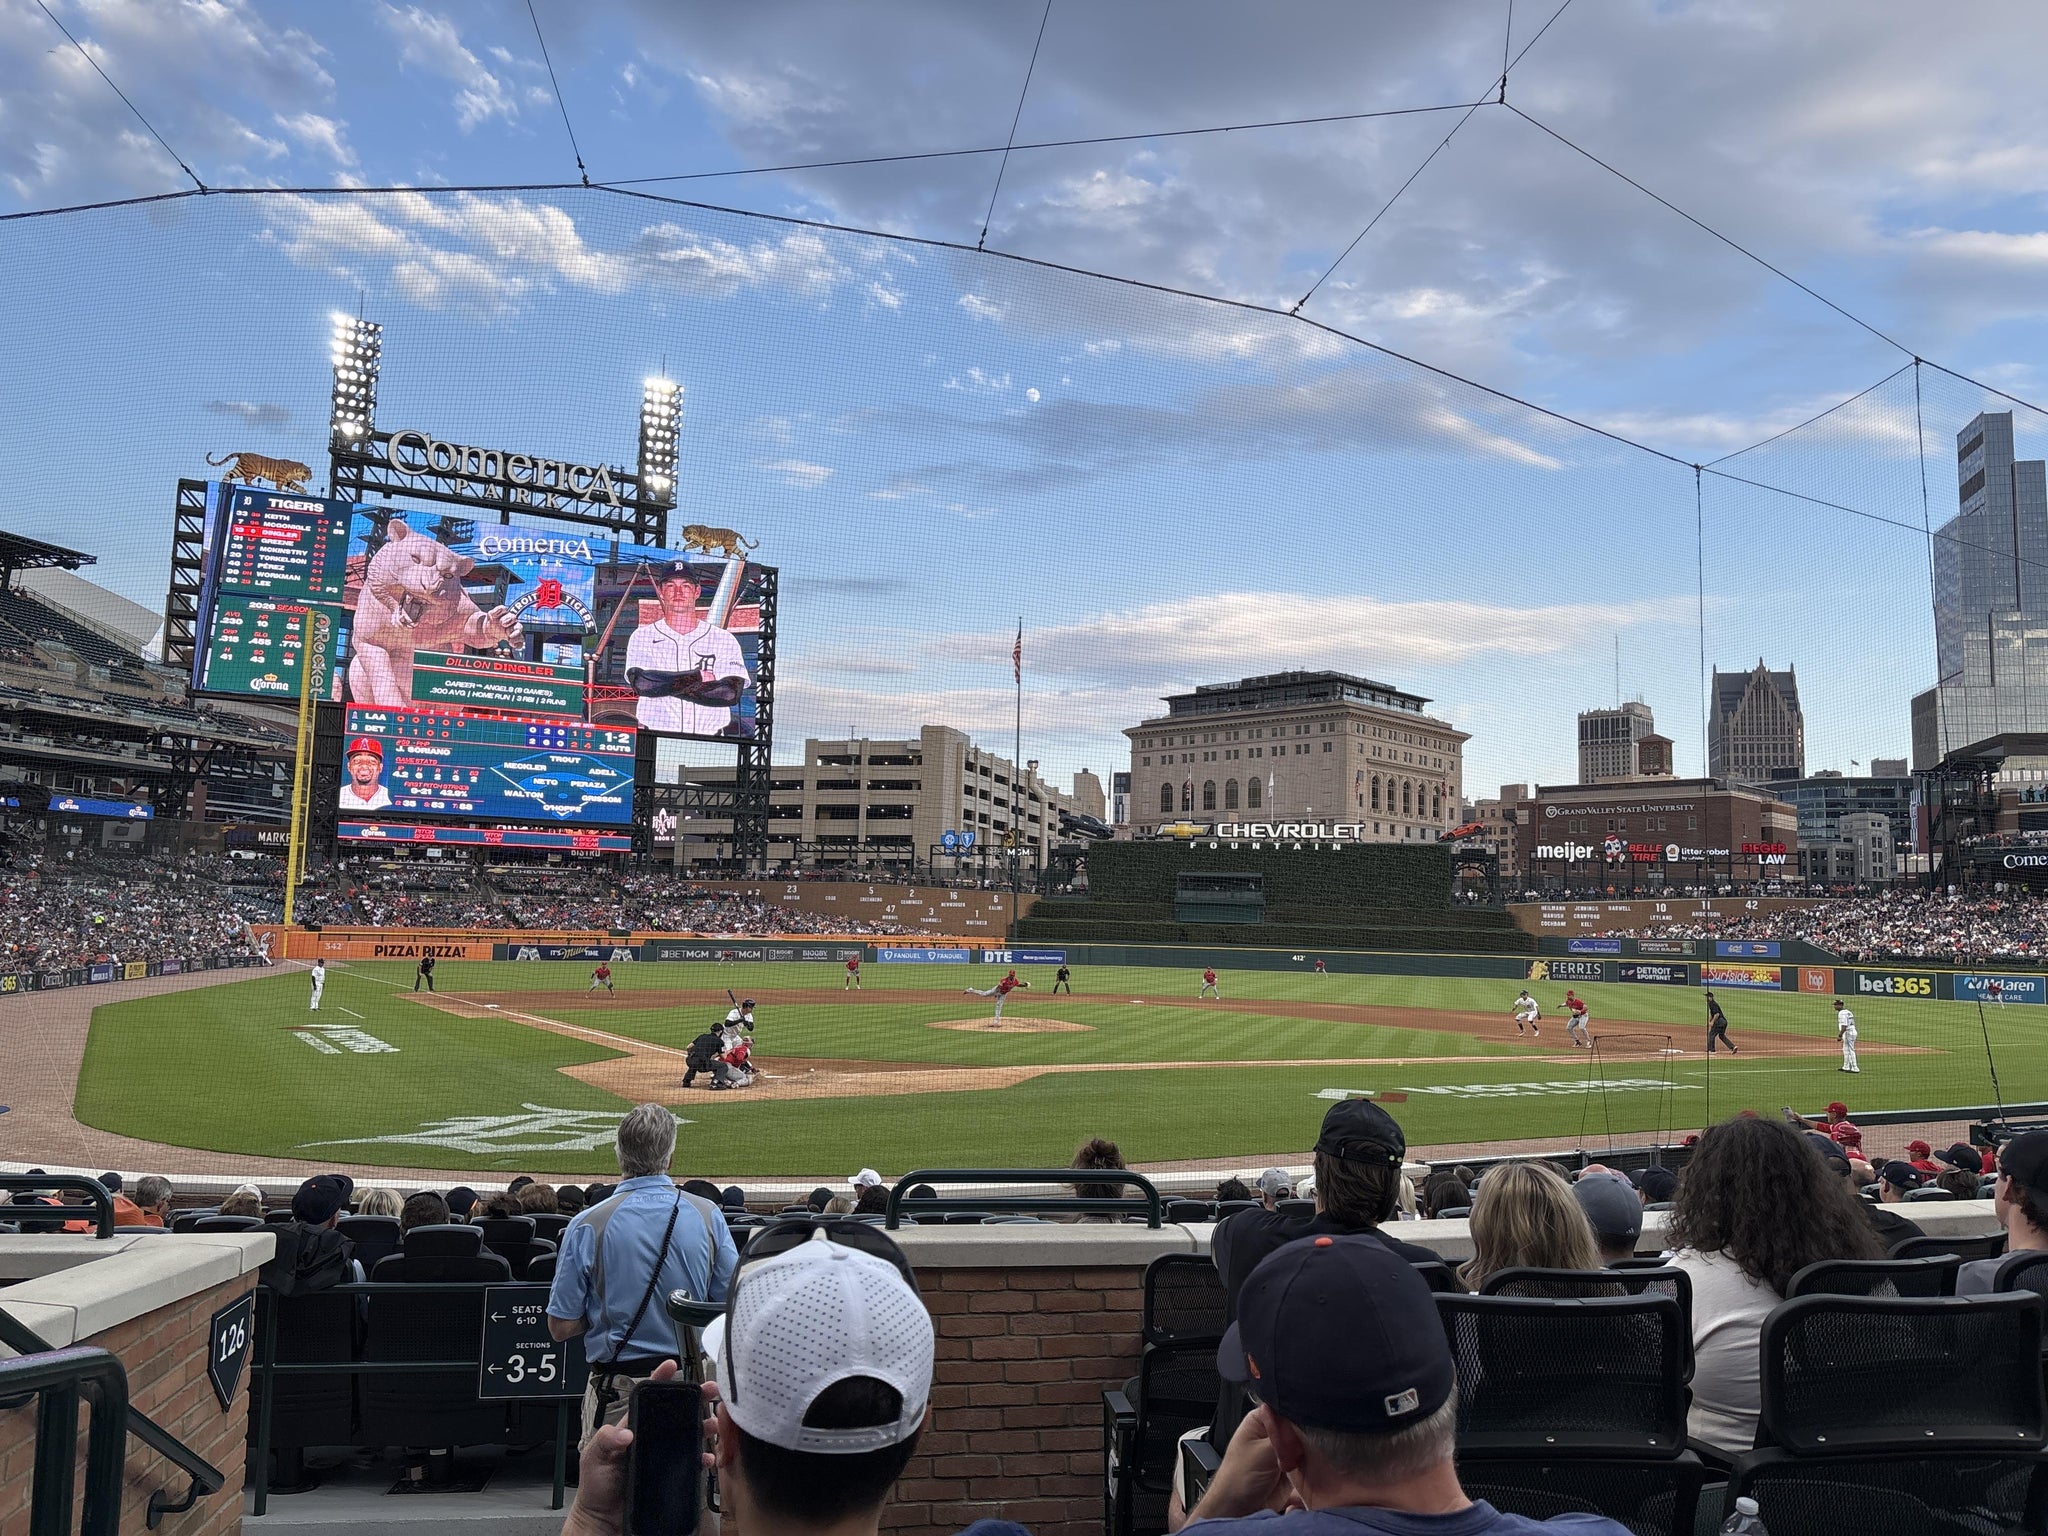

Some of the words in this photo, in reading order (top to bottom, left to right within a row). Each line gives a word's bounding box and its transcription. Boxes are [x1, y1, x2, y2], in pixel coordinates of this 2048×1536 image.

[455, 479, 562, 509] PARK
[268, 498, 324, 512] TIGERS
[263, 522, 311, 531] MCGONIGLE
[262, 530, 297, 538] DINGLER
[260, 546, 308, 556] MCKINSTRY
[259, 554, 307, 564] TORKELSON
[513, 558, 563, 567] PARK
[256, 572, 300, 581] WORKMAN
[276, 604, 312, 613] SEASON
[566, 595, 595, 628] TIGERS
[446, 658, 491, 669] DILLON
[493, 660, 554, 676] DINGLER
[250, 678, 288, 691] Corona
[445, 680, 475, 688] CAREER
[484, 684, 513, 692] ANGELS
[605, 732, 630, 743] 1-2
[408, 747, 451, 755] SORIANO
[504, 762, 546, 771] MECKLER
[570, 780, 606, 789] PERAZA
[504, 790, 544, 798] WALTON
[582, 795, 622, 803] GRISSOM
[59, 802, 79, 810] Corona
[1558, 806, 1586, 815] GRAND
[1586, 806, 1615, 814] VALLEY
[1616, 806, 1641, 814] STATE
[1642, 804, 1694, 813] UNIVERSITY
[361, 828, 386, 837] Corona
[1217, 824, 1365, 838] CHEVROLET
[1190, 842, 1341, 850] FOUNTAIN
[1741, 843, 1786, 853] FIEGER
[1537, 841, 1594, 862] meijer
[1682, 848, 1729, 856] litter-robot
[1759, 854, 1786, 864] LAW
[2004, 854, 2048, 868] Come
[950, 892, 958, 900] 16
[993, 895, 998, 903] 6
[1656, 903, 1666, 912] 10
[1702, 901, 1710, 909] 11
[1745, 901, 1758, 910] 42
[374, 945, 419, 957] PIZZA!
[422, 946, 466, 958] PIZZA!
[561, 946, 588, 960] Miller
[985, 951, 1012, 962] DTE
[1552, 962, 1601, 974] FERRIS
[1708, 966, 1749, 982] Surfside
[1808, 972, 1823, 990] hop
[1859, 974, 1931, 994] bet365
[1393, 1079, 1678, 1094] VICTORS
[512, 1306, 542, 1314] SEATS
[516, 1316, 537, 1325] 6-10
[220, 1317, 244, 1362] 126
[506, 1354, 556, 1382] 3-5
